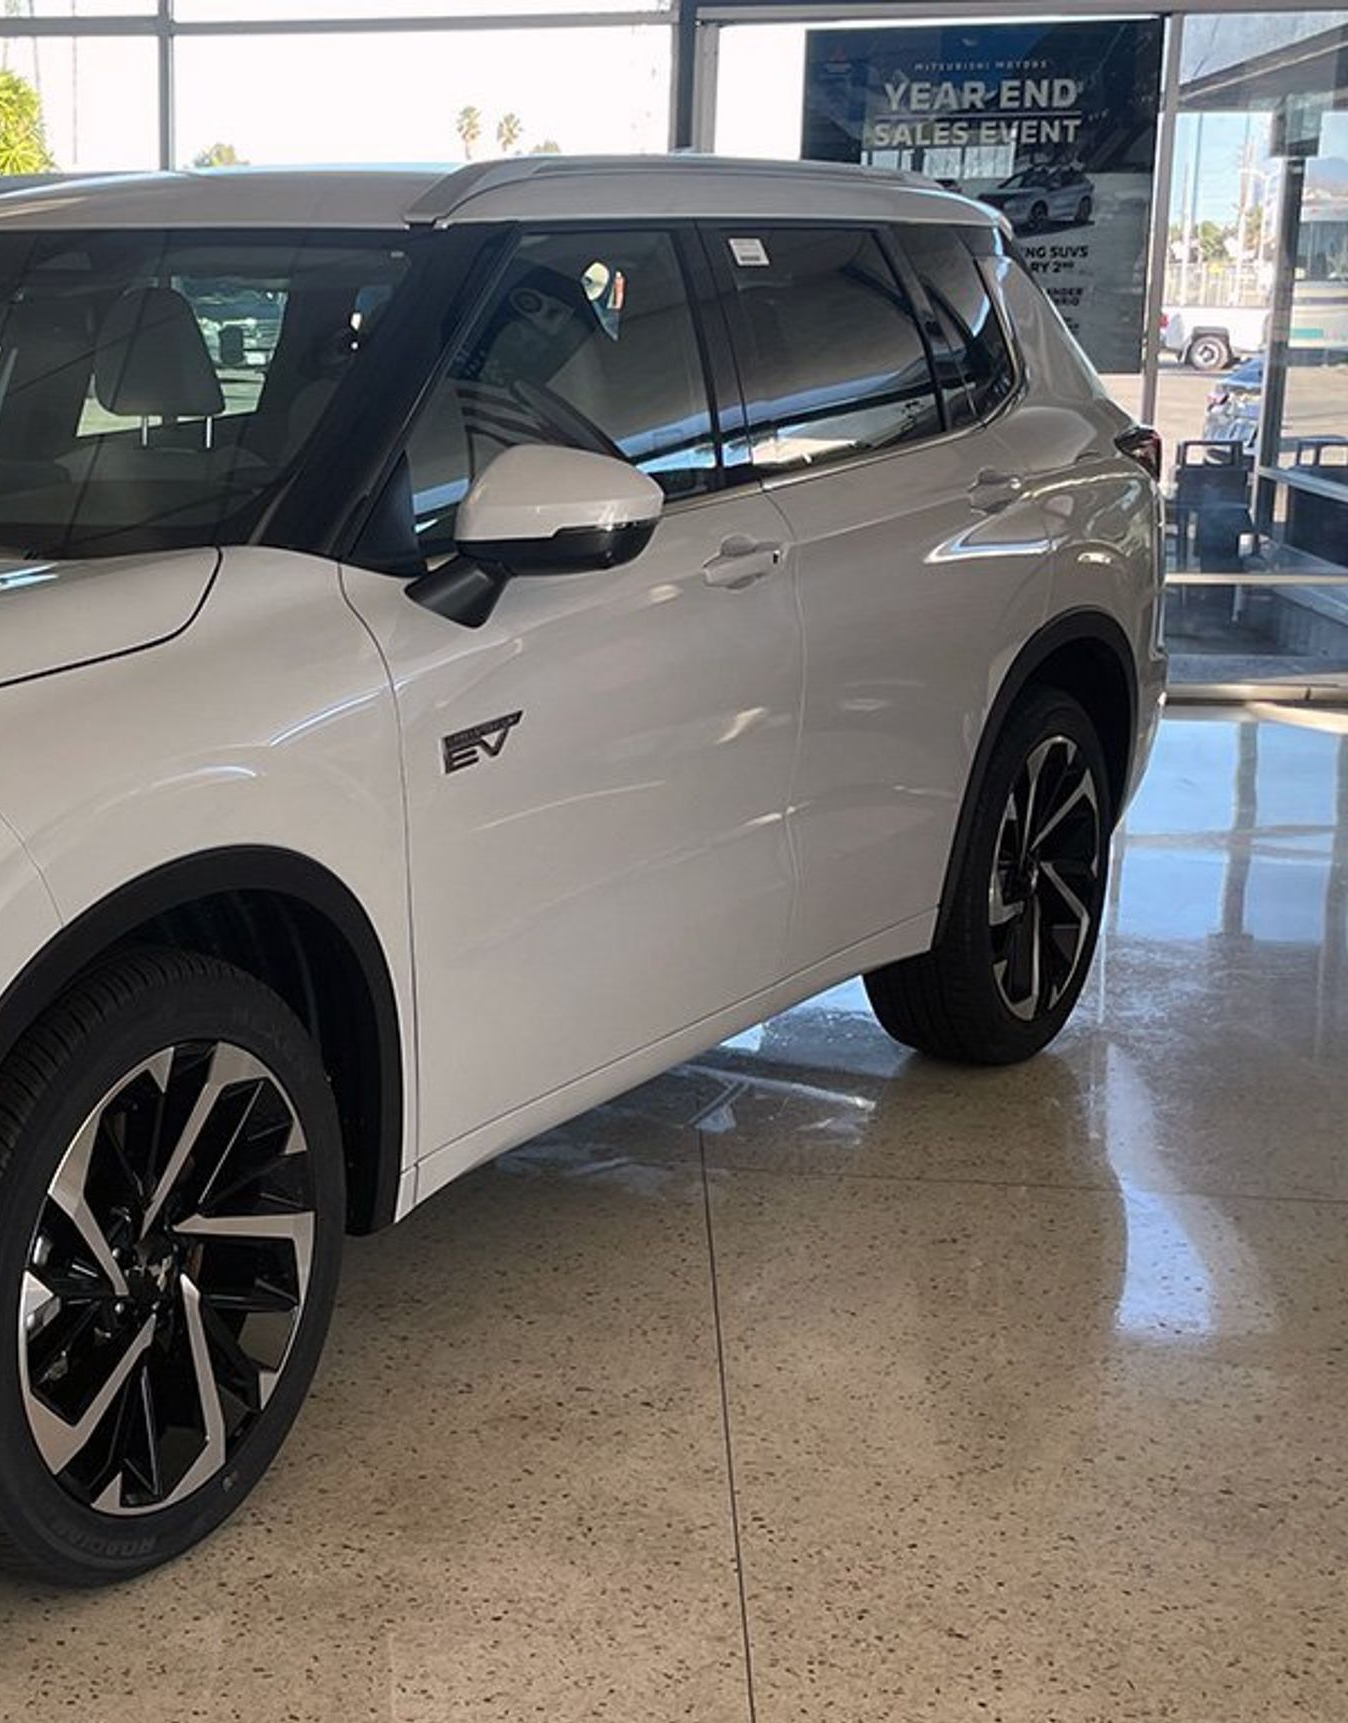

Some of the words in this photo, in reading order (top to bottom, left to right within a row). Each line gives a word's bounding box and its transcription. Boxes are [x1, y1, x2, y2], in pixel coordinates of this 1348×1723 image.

[995, 59, 1048, 71] MOTORS
[884, 80, 986, 112] YEAR
[999, 78, 1079, 110] END
[873, 120, 970, 147] SALES
[979, 119, 1082, 145] EVENT
[1049, 245, 1090, 258] SUVS
[442, 710, 524, 775] EV
